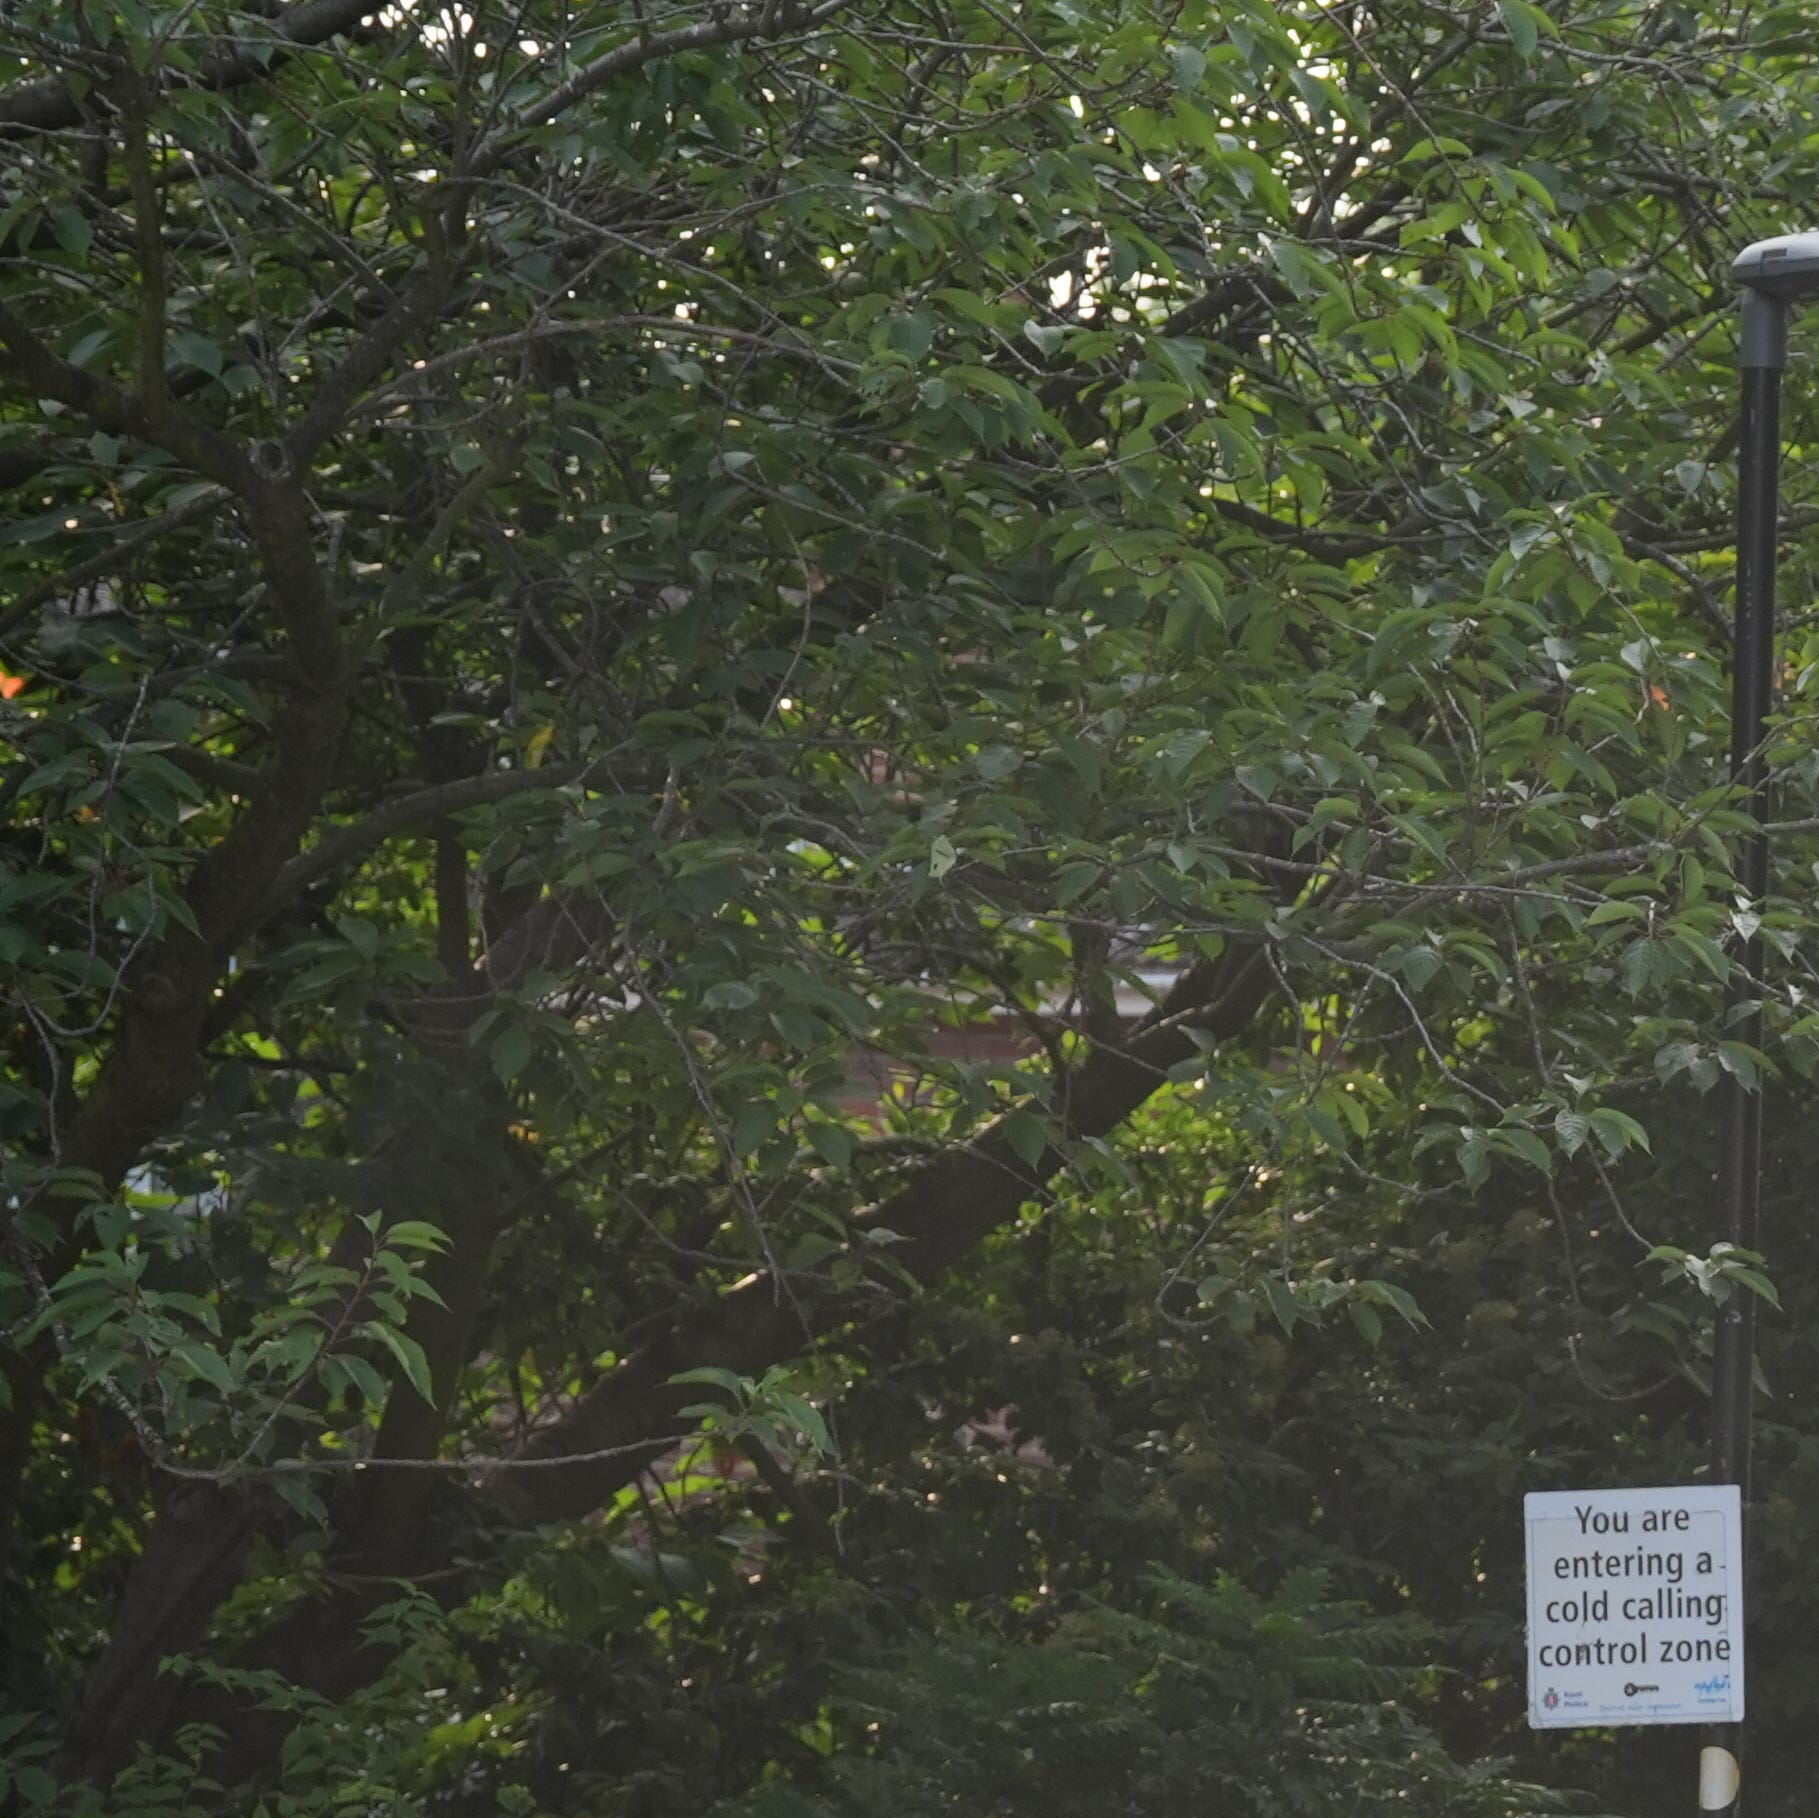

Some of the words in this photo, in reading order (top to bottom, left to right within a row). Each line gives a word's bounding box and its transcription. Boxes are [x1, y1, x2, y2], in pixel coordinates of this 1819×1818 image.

[1574, 1505, 1629, 1534] You
[1642, 1507, 1690, 1532] are
[1554, 1545, 1683, 1584] entering
[1696, 1551, 1713, 1574] a
[1546, 1589, 1609, 1623] cold
[1622, 1587, 1722, 1626] calling
[1539, 1632, 1647, 1667] control
[1660, 1637, 1731, 1663] zone
